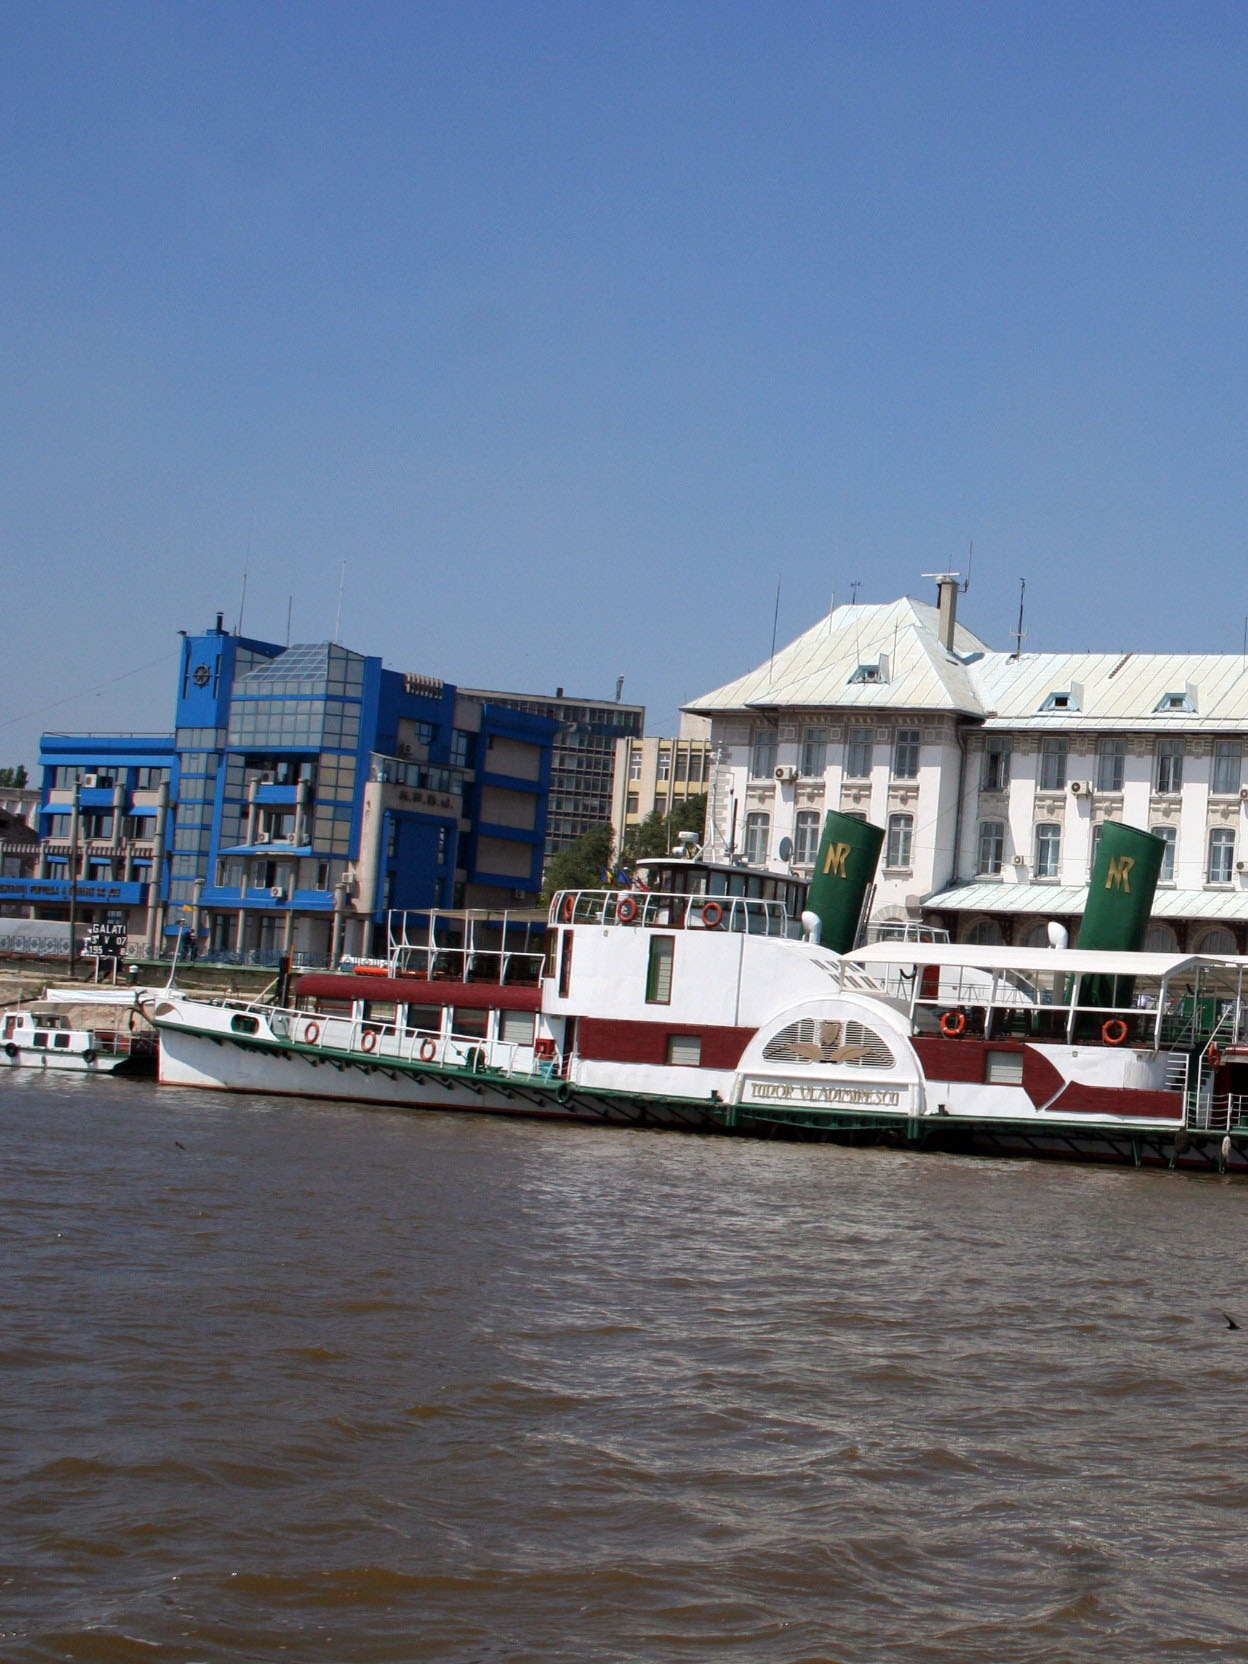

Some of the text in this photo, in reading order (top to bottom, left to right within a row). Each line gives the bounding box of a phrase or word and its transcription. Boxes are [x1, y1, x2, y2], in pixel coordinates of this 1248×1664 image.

[93, 924, 126, 934] GALATI
[116, 937, 127, 946] 07
[752, 1082, 794, 1099] TUDOR
